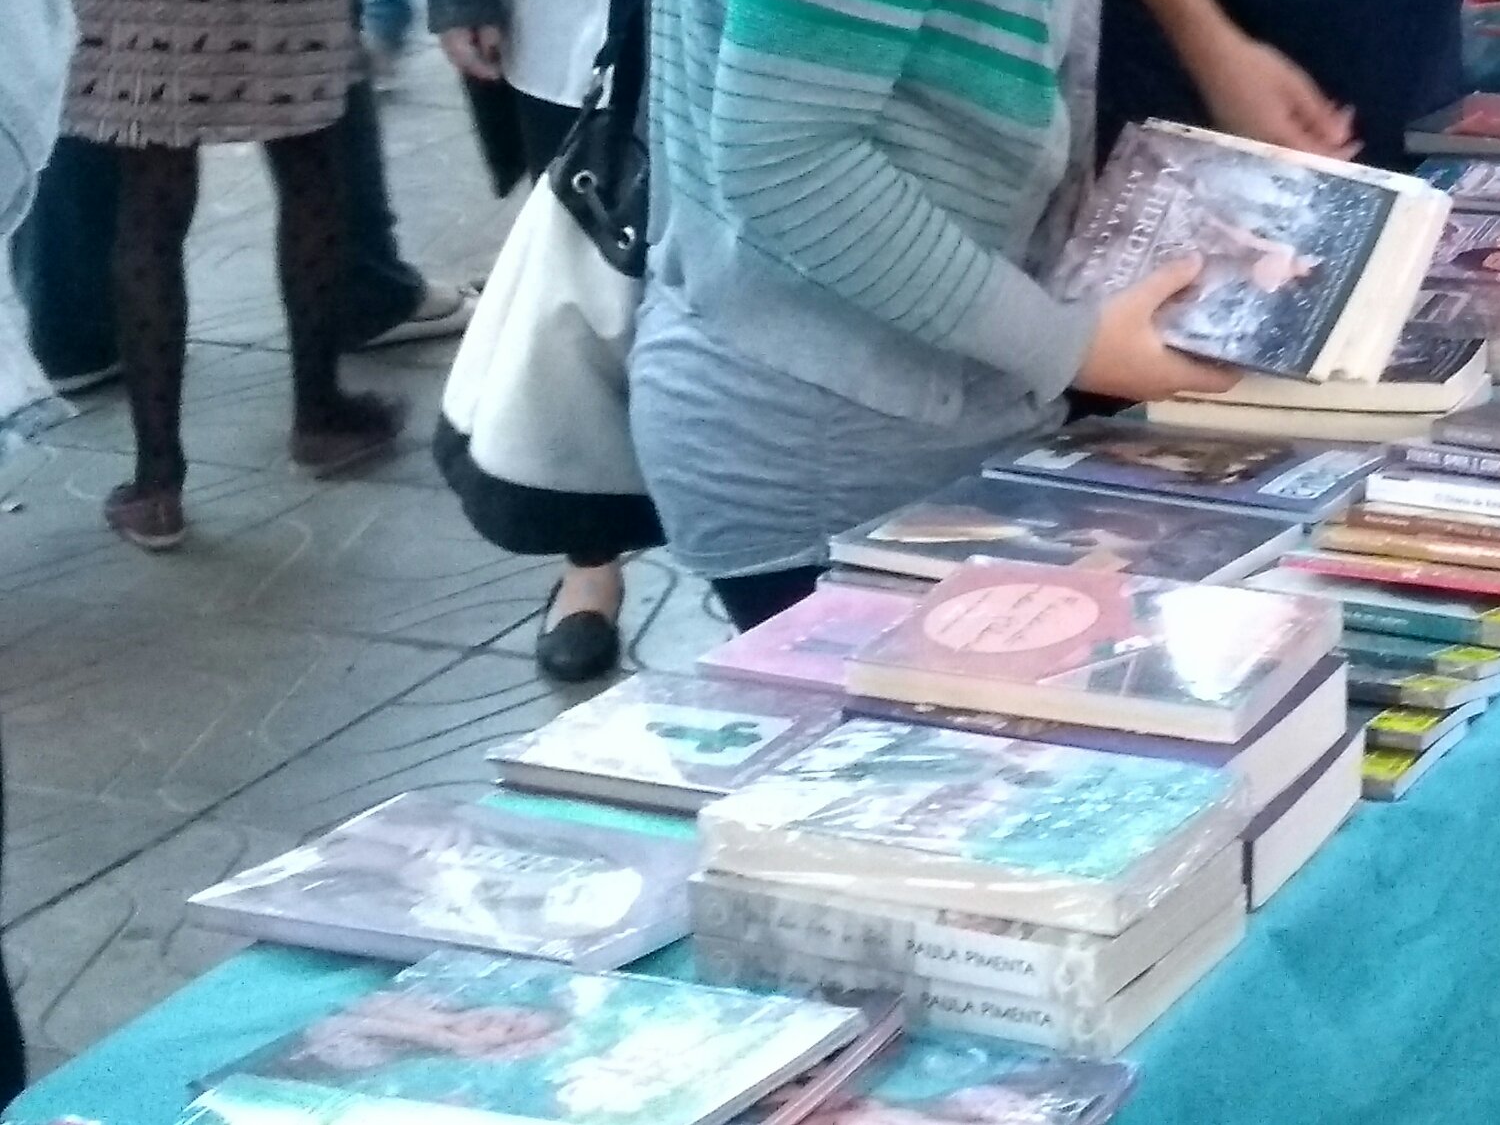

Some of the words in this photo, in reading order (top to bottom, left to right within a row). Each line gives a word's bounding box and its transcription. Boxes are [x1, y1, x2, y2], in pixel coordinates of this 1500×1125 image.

[905, 938, 960, 962] PAULA
[965, 949, 1036, 976] PIMENTA
[920, 990, 975, 1014] PAULA
[980, 1000, 1054, 1027] PIMENTA
